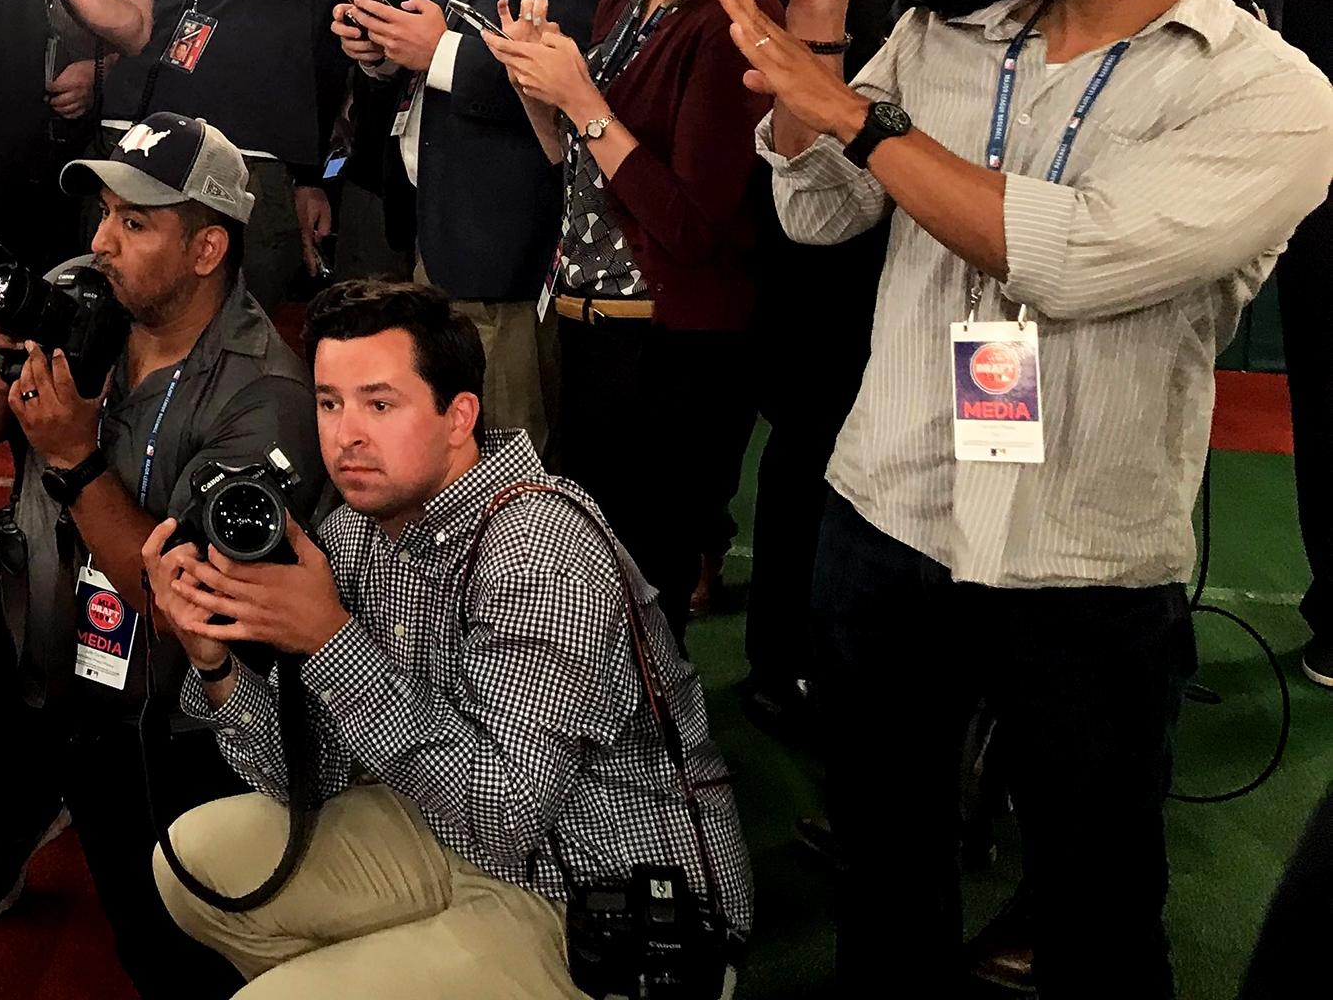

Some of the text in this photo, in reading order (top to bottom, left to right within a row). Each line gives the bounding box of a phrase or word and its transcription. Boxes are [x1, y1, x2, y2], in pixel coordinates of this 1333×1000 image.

[963, 400, 1031, 419] MEDIA
[200, 472, 226, 493] Canon
[91, 603, 120, 619] DRAFT
[77, 629, 122, 657] MEDIA
